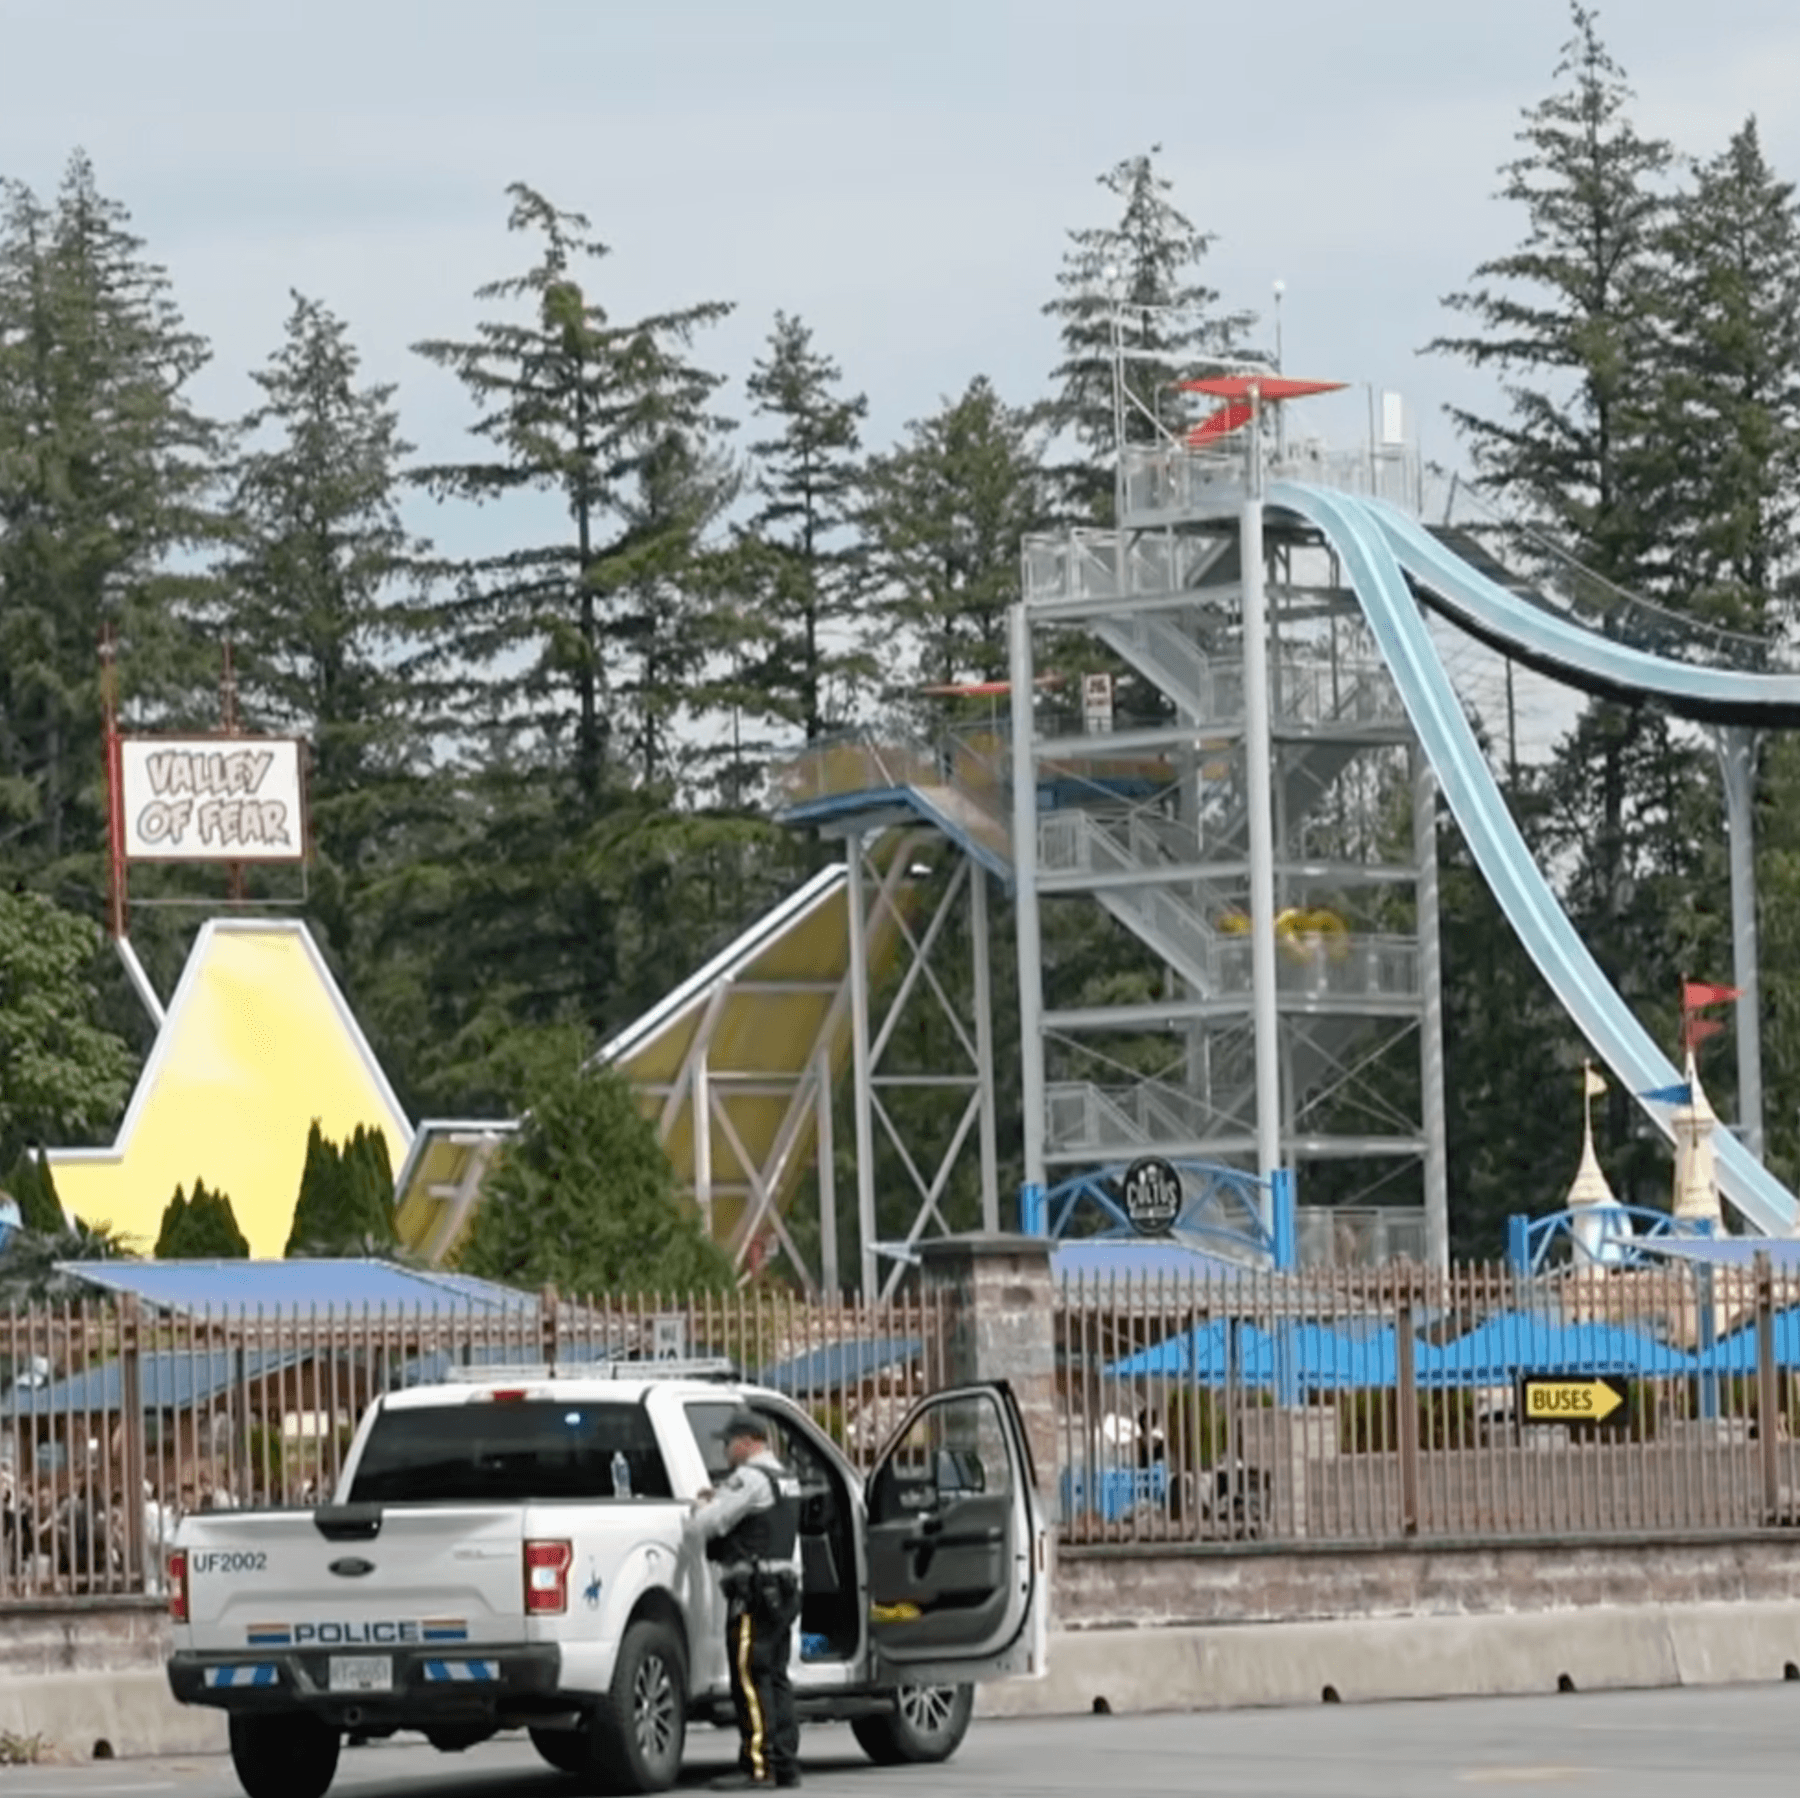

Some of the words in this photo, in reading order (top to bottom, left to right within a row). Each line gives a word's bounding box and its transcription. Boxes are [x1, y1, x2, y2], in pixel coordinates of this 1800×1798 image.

[145, 749, 275, 797] VALLEY
[136, 798, 193, 846] OF
[197, 798, 292, 848] FEAR
[1533, 1388, 1594, 1411] BUSES
[193, 1552, 267, 1573] UF2002
[294, 1620, 418, 1643] POLICE
